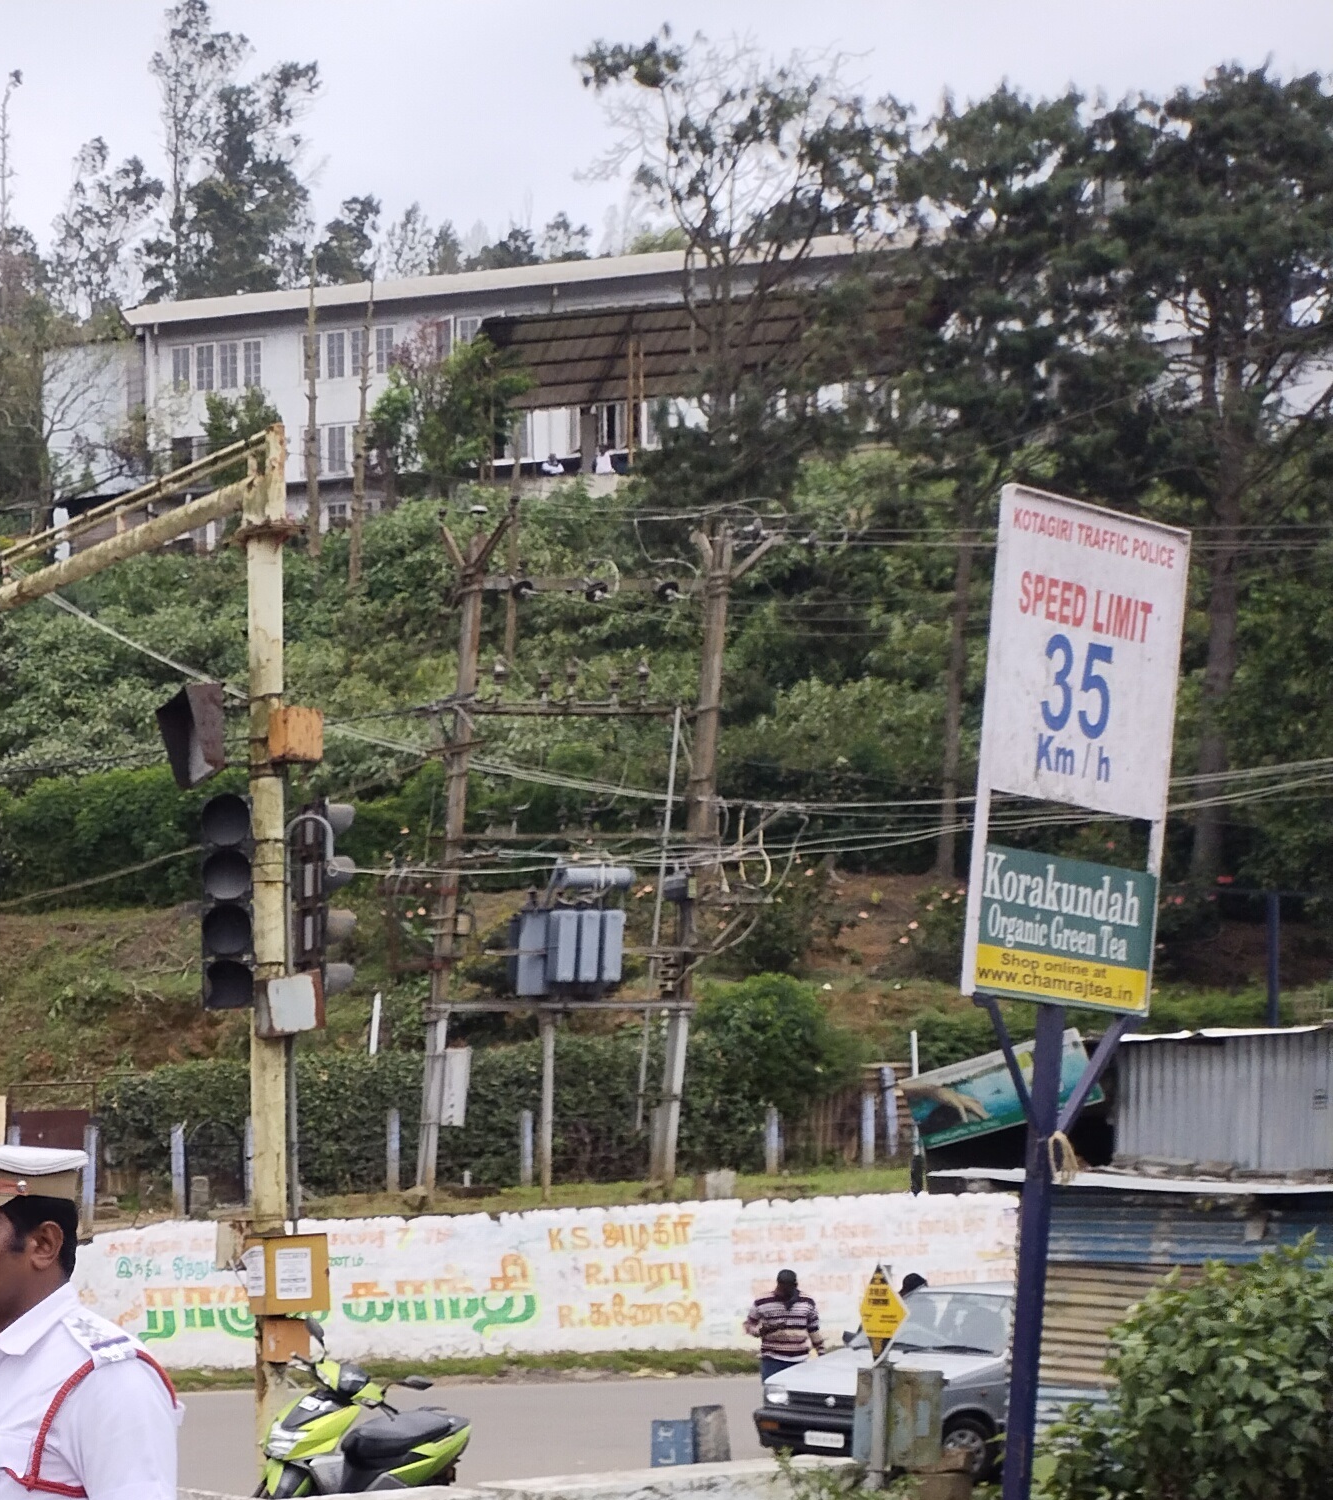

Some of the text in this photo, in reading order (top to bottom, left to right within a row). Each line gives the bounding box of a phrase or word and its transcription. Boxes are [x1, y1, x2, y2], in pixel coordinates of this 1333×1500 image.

[1013, 507, 1175, 569] KOTAGIRI TRAFFIC POLICE
[1018, 571, 1154, 643] SPEED LIMIT
[1040, 634, 1114, 740] 35
[984, 852, 1140, 928] Korakundah
[987, 904, 1128, 962] Organic Green Tea
[977, 966, 1133, 1002] www.chamrajtea.in
[1000, 952, 1107, 979] Shop online at
